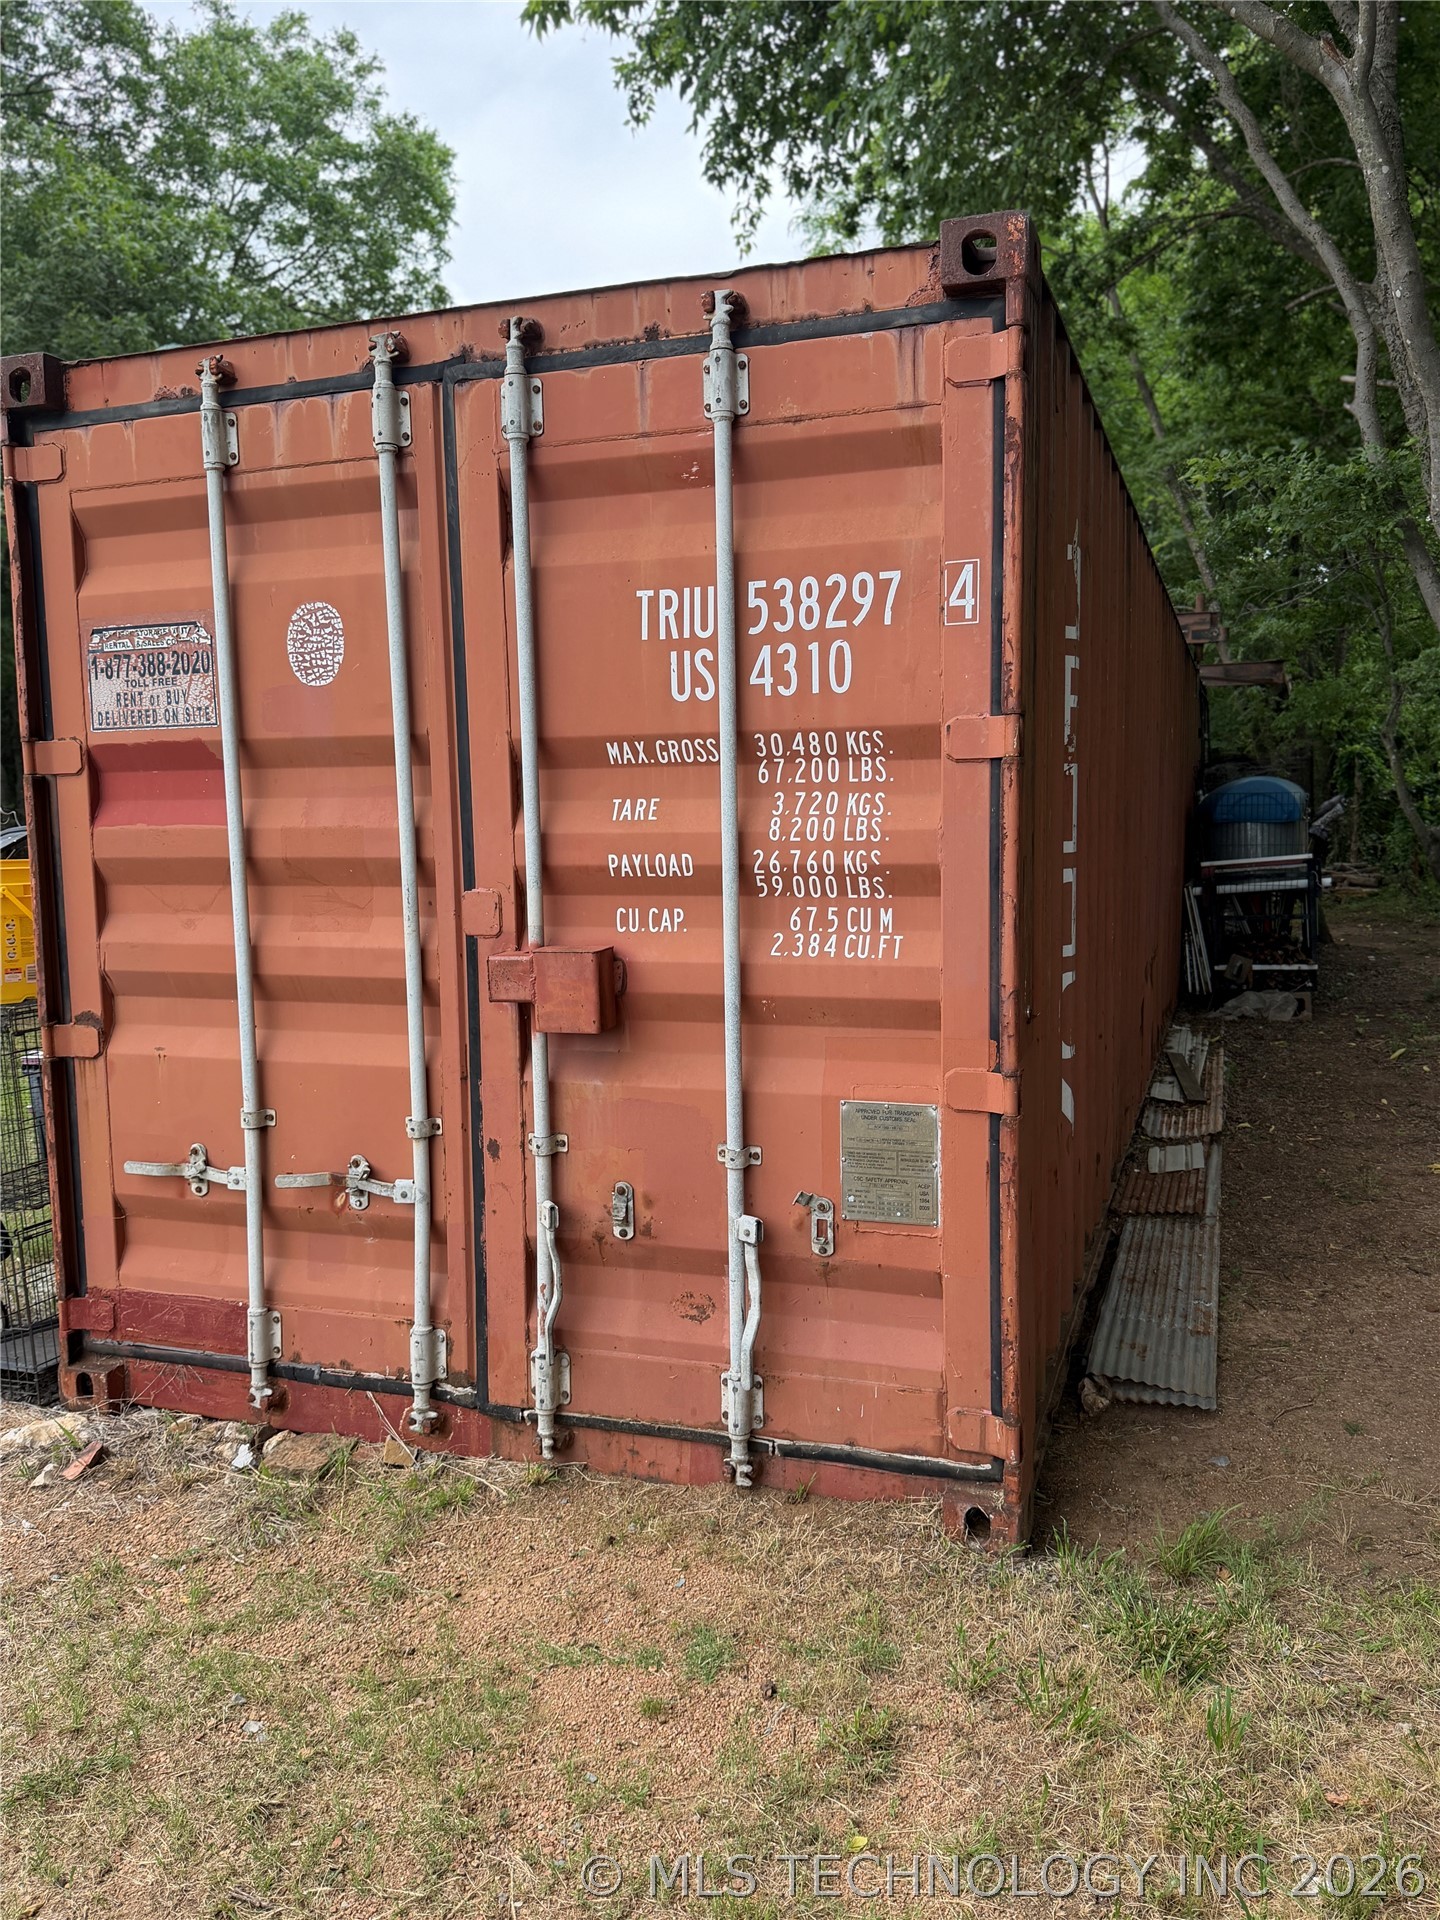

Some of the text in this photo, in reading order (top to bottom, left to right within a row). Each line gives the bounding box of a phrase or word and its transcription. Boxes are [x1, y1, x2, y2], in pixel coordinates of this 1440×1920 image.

[636, 563, 976, 641] TRIU 538297 4
[104, 641, 131, 650] RENTAL
[91, 651, 211, 680] 1-877-388-2020
[671, 639, 853, 702] US 4310
[125, 677, 177, 689] TOLL FREE
[116, 689, 187, 708] RENT or BUY
[97, 706, 211, 727] DELIVERED ON SITE
[606, 730, 894, 765] MAX.GROSS 30,480 KGS.
[757, 756, 895, 785] 67,200 LBS.
[612, 790, 893, 822] TARE 3,720 KGS.
[768, 816, 892, 843] 8,200 LBS.
[607, 853, 694, 878] PAYLOAD
[753, 849, 836, 875] 26,760
[755, 875, 893, 900] 59,000 LBS.
[616, 906, 894, 934] CU.CAP. 67.5 CU M
[770, 932, 905, 960] 2,384 CU.FT
